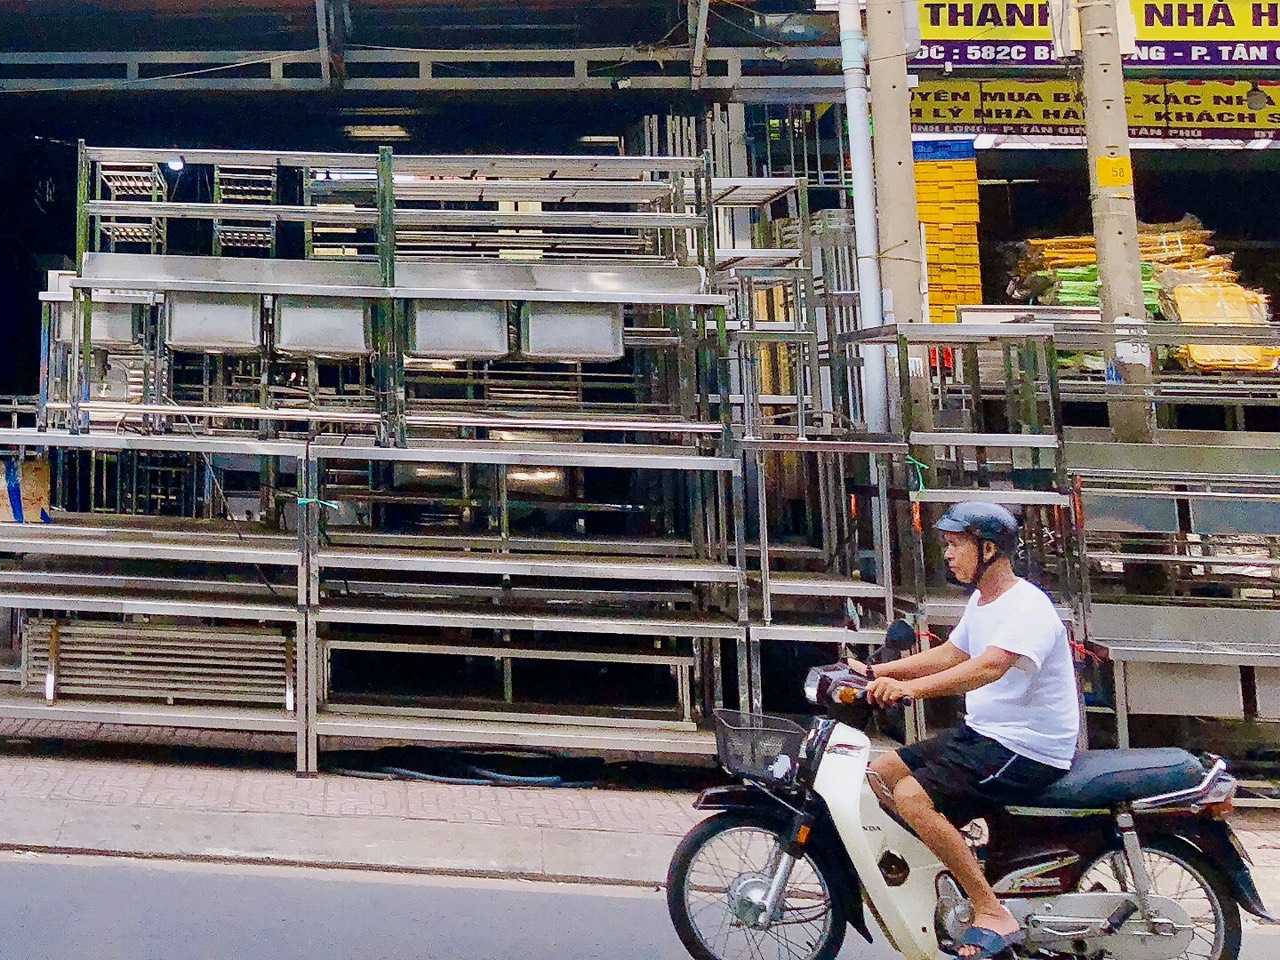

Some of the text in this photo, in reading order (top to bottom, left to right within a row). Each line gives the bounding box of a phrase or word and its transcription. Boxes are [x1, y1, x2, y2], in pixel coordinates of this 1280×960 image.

[966, 45, 1027, 60] 582C
[1191, 45, 1211, 61] P.
[1217, 43, 1268, 61] TÂN
[981, 91, 1044, 103] MUA
